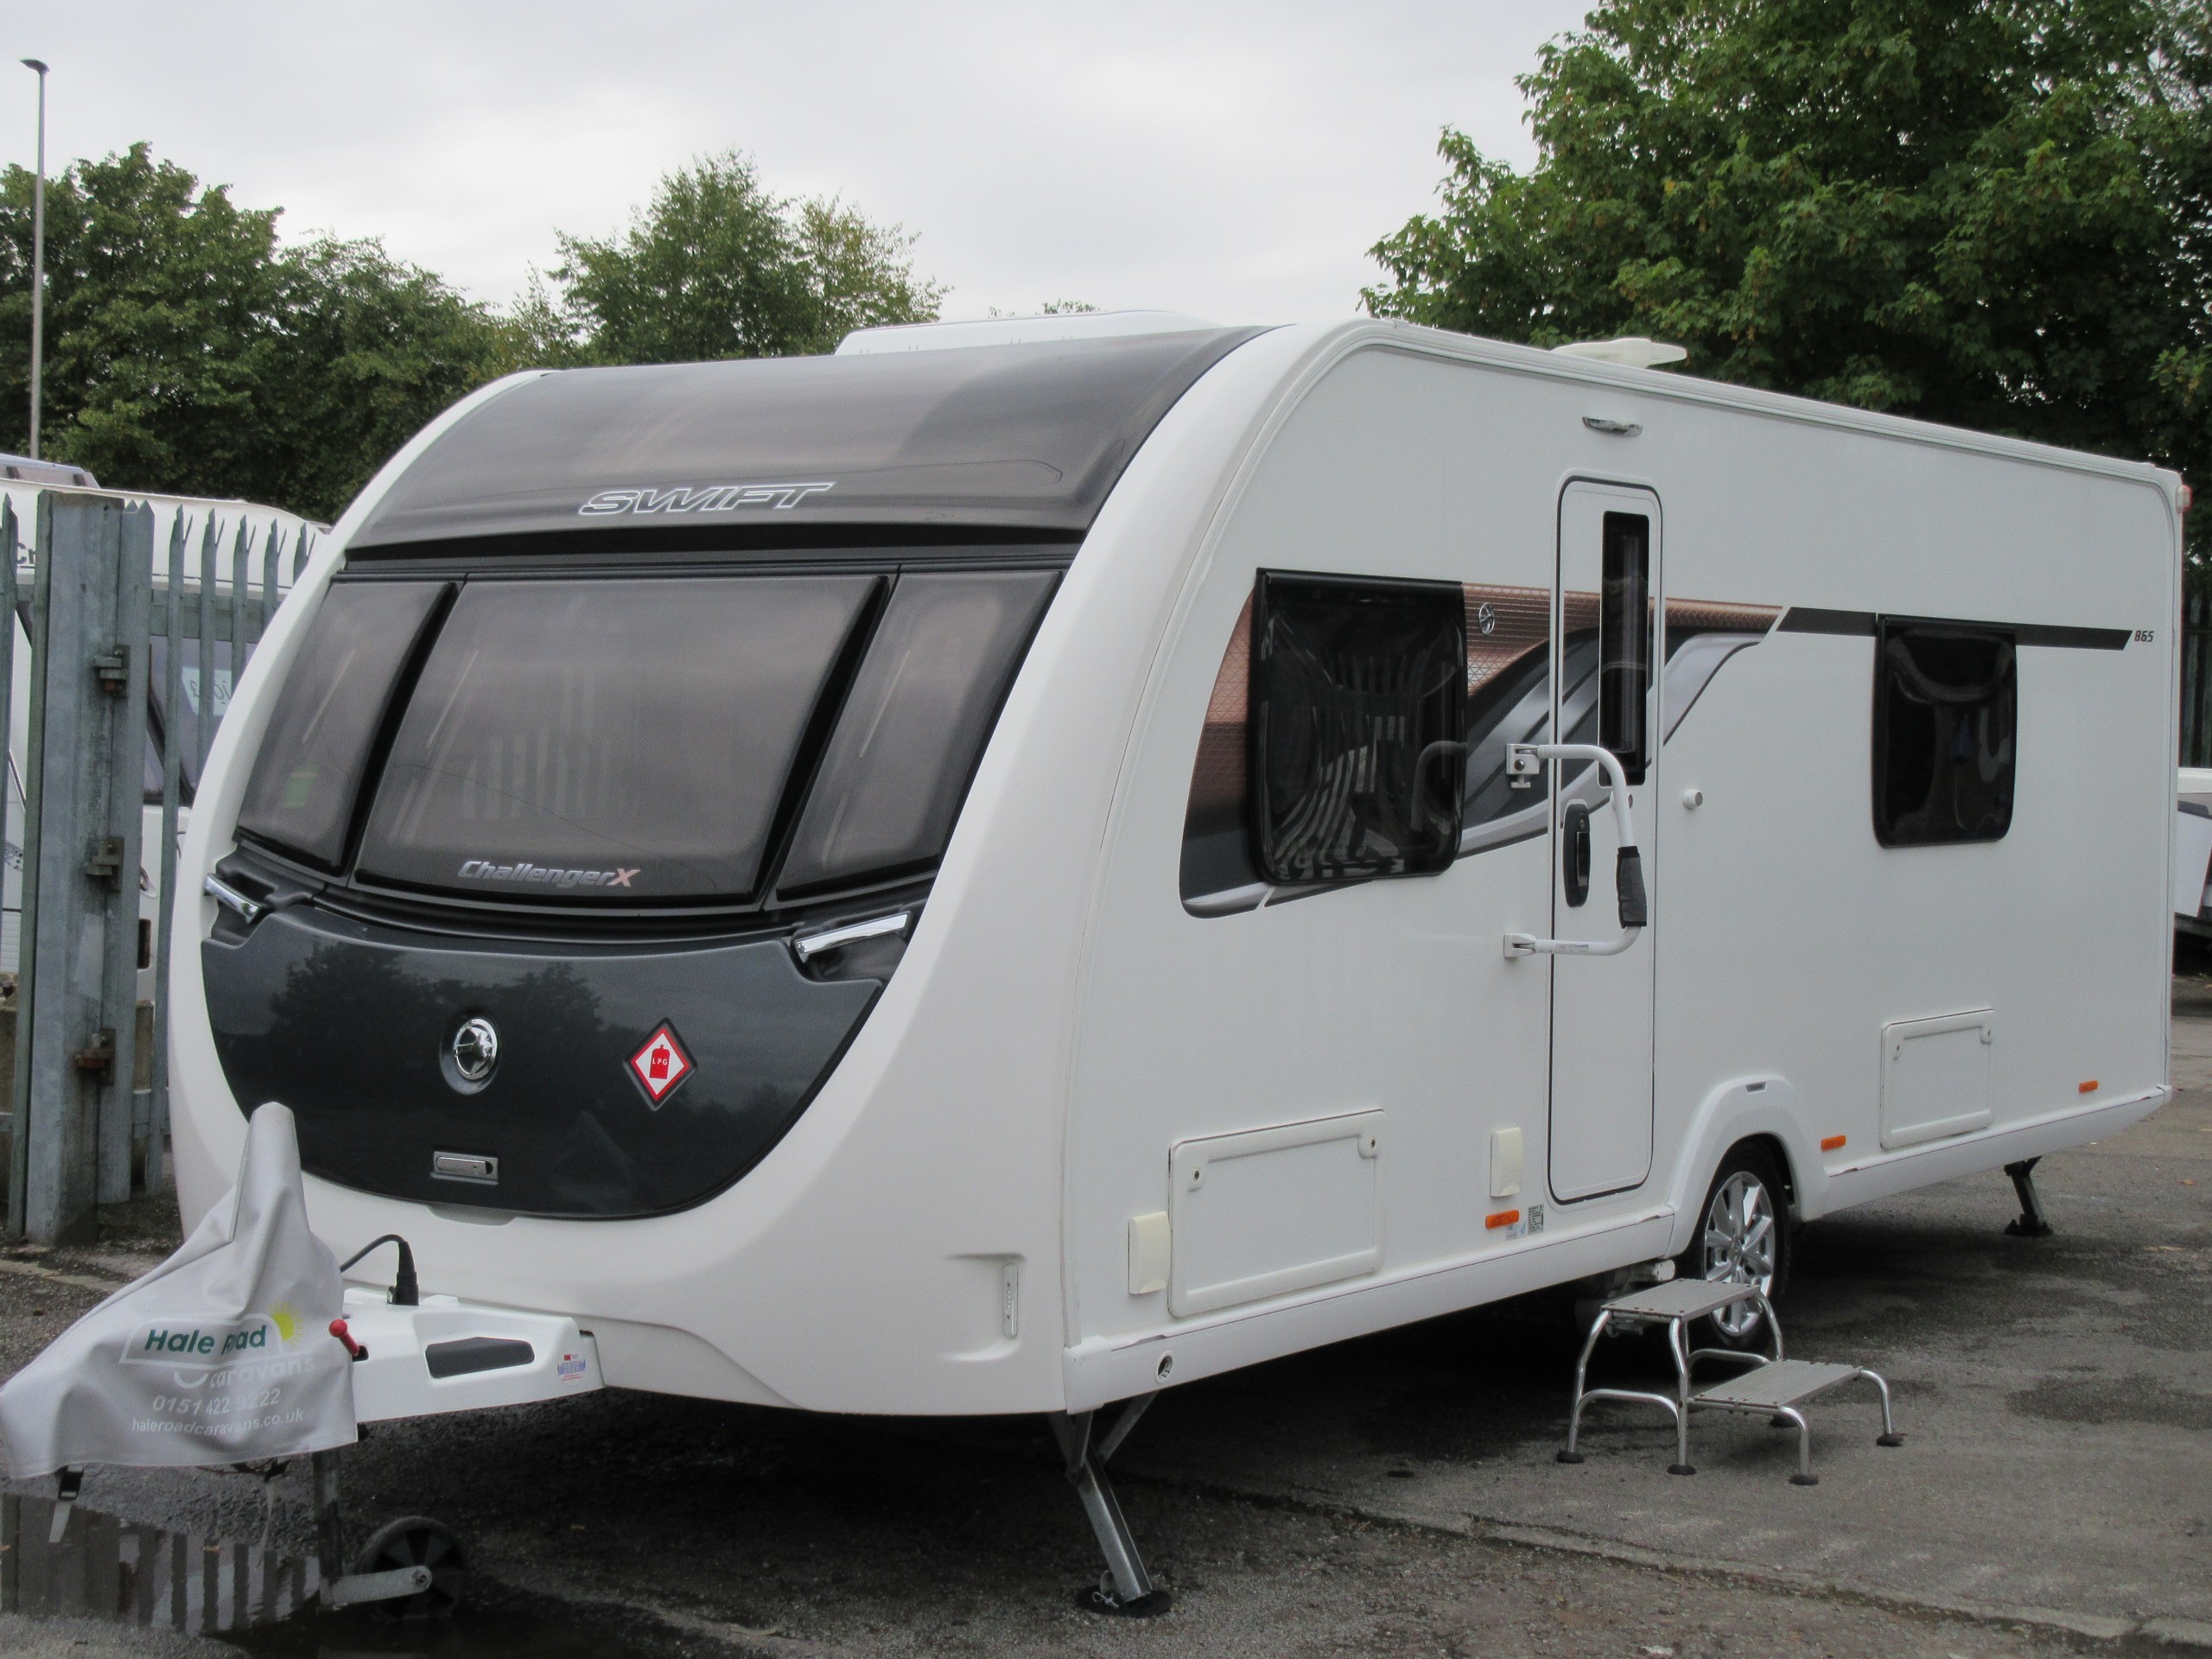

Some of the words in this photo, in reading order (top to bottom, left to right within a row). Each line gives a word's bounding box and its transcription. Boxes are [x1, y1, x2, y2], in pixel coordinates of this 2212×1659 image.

[578, 481, 836, 515] SWIFT
[2134, 630, 2154, 642] 865
[144, 1329, 215, 1355] Hale
[221, 1325, 267, 1355] Rad
[210, 1356, 315, 1389] caravans
[152, 1395, 202, 1416] 0151
[206, 1396, 231, 1415] 422
[132, 1408, 303, 1437] haleroadcaravans.co.uk
